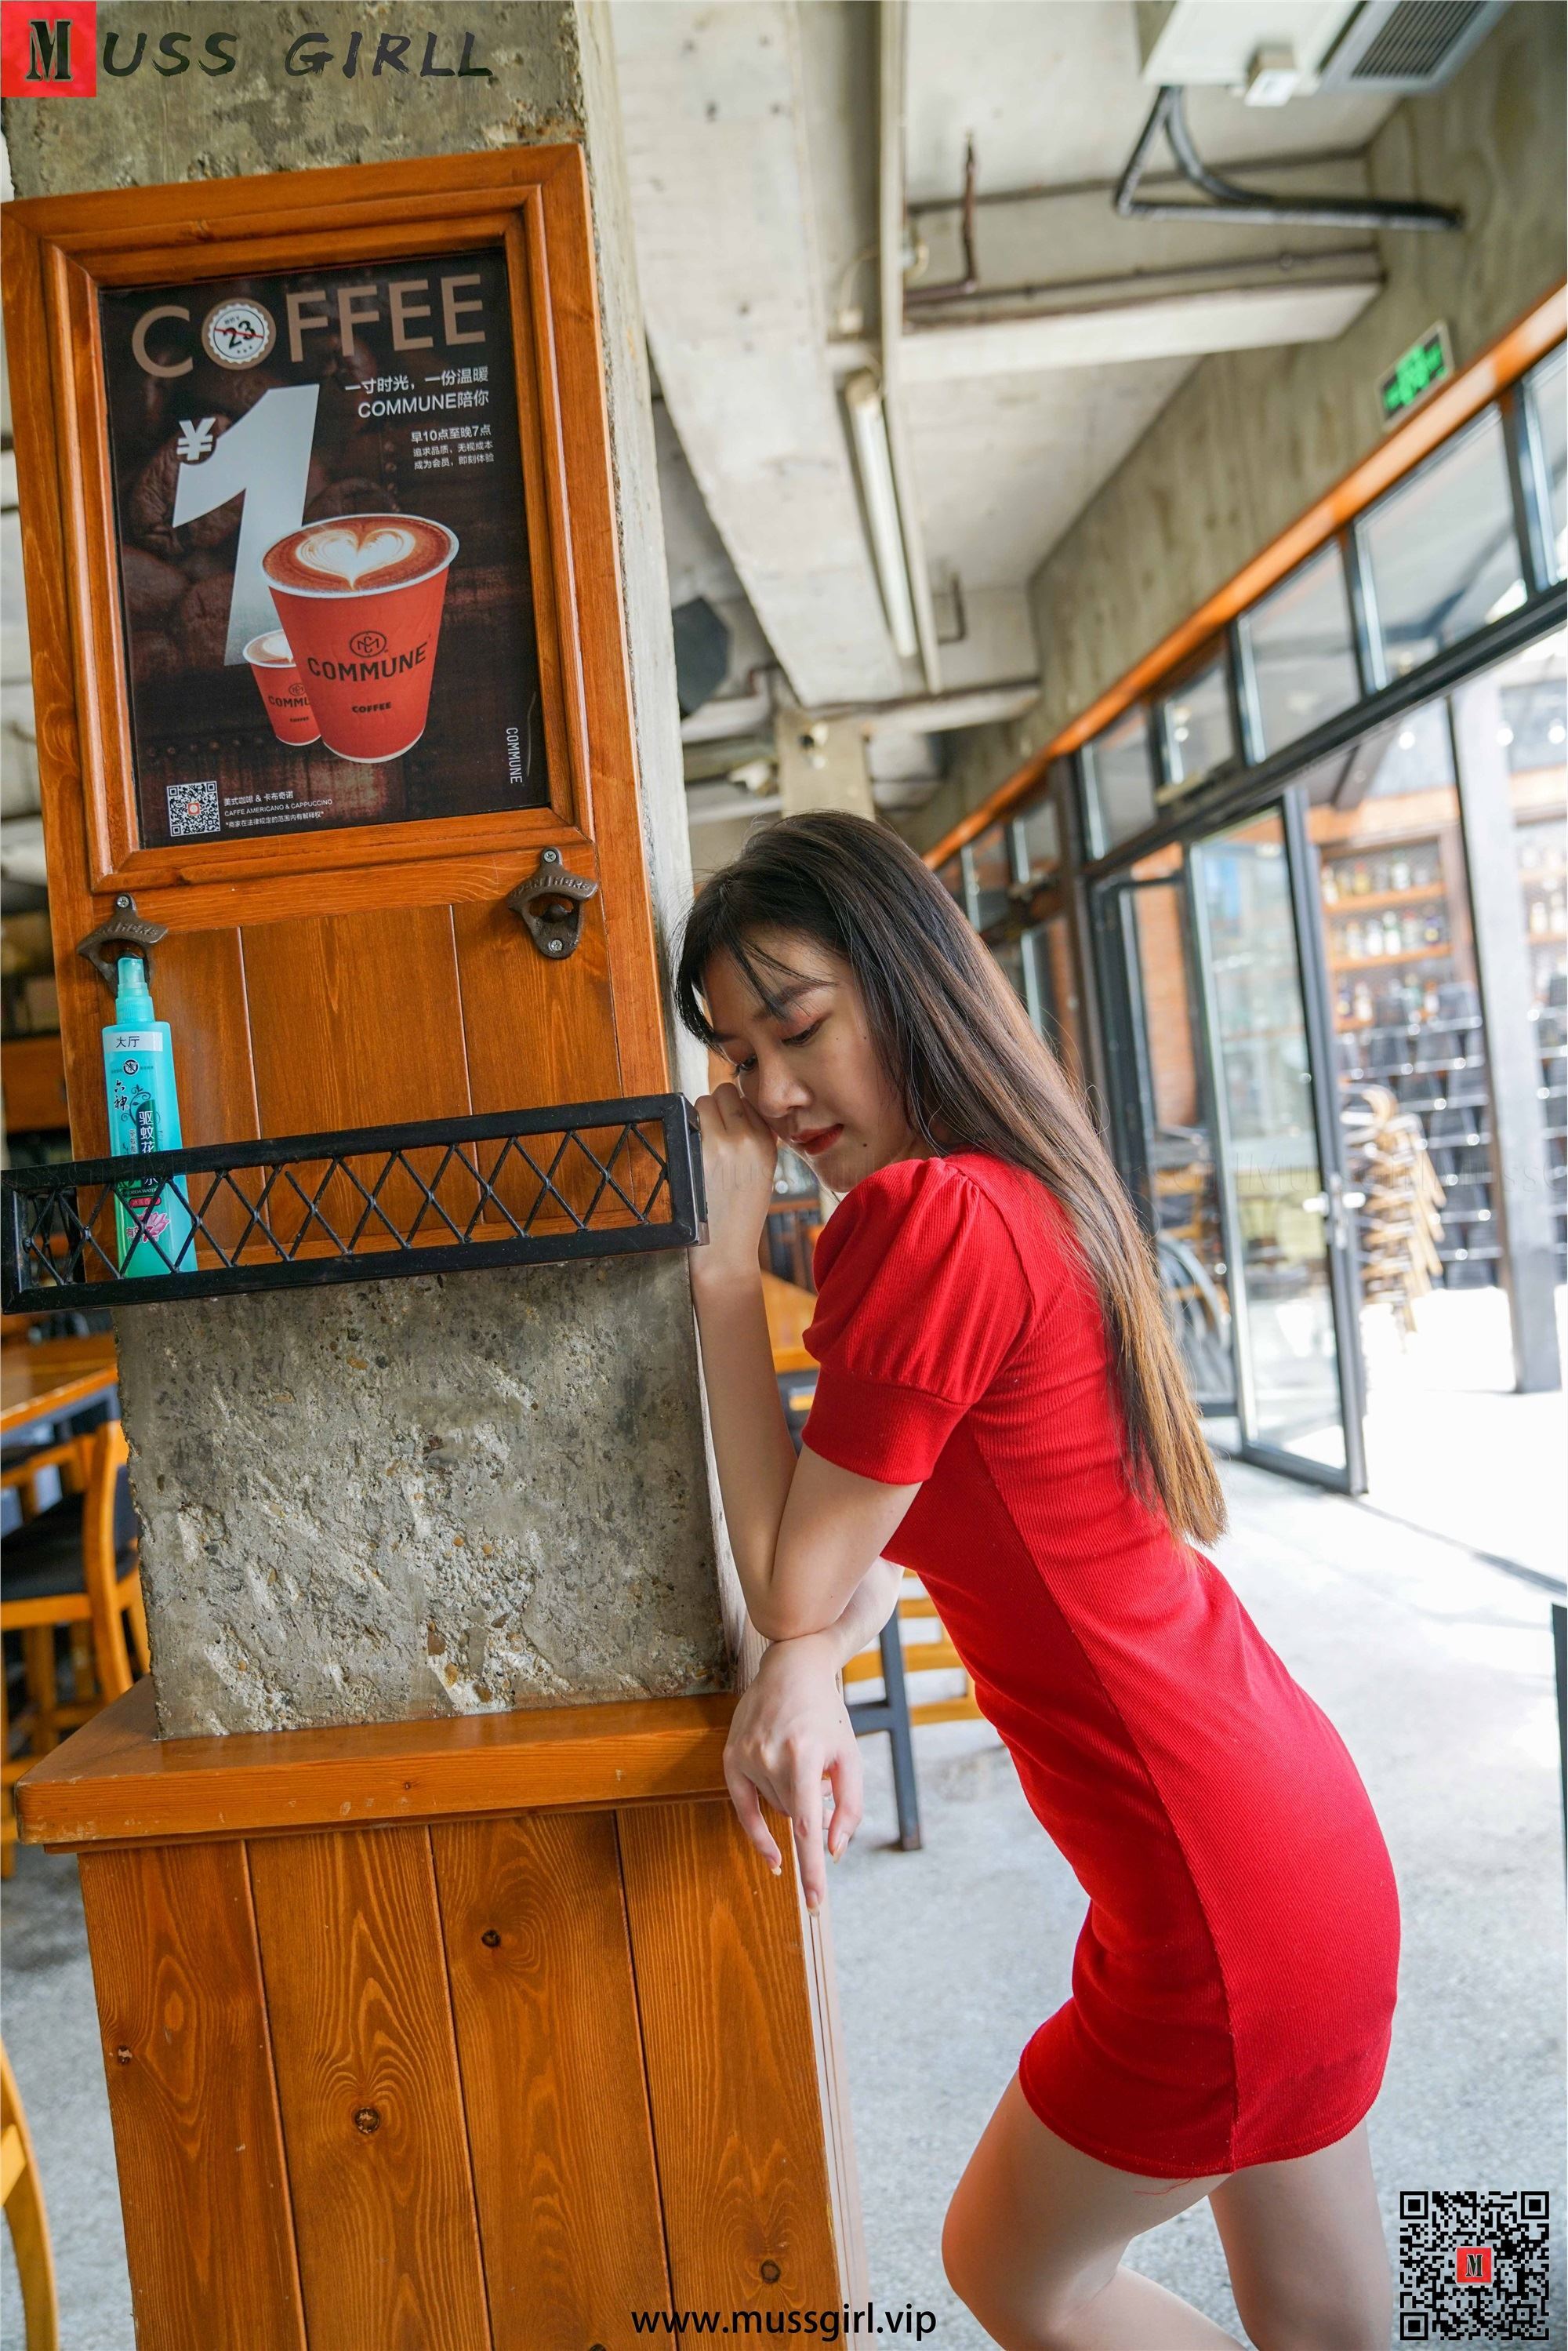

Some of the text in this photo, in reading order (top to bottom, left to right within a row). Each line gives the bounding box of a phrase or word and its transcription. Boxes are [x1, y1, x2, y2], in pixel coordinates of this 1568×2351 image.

[132, 274, 486, 378] COFFEE
[223, 320, 256, 350] 23
[345, 365, 489, 394] 一寸时光，一份温暖
[411, 424, 492, 445] 早10点至晚7点
[307, 641, 428, 682] COMMUNE
[351, 702, 392, 714] COFFEE
[506, 727, 523, 784] COMMUNE
[224, 808, 245, 816] CAFFE
[246, 804, 284, 814] AMERICANO
[291, 798, 332, 808] CAPPUCCINO
[255, 794, 262, 803] &
[115, 1035, 140, 1048] 大厅
